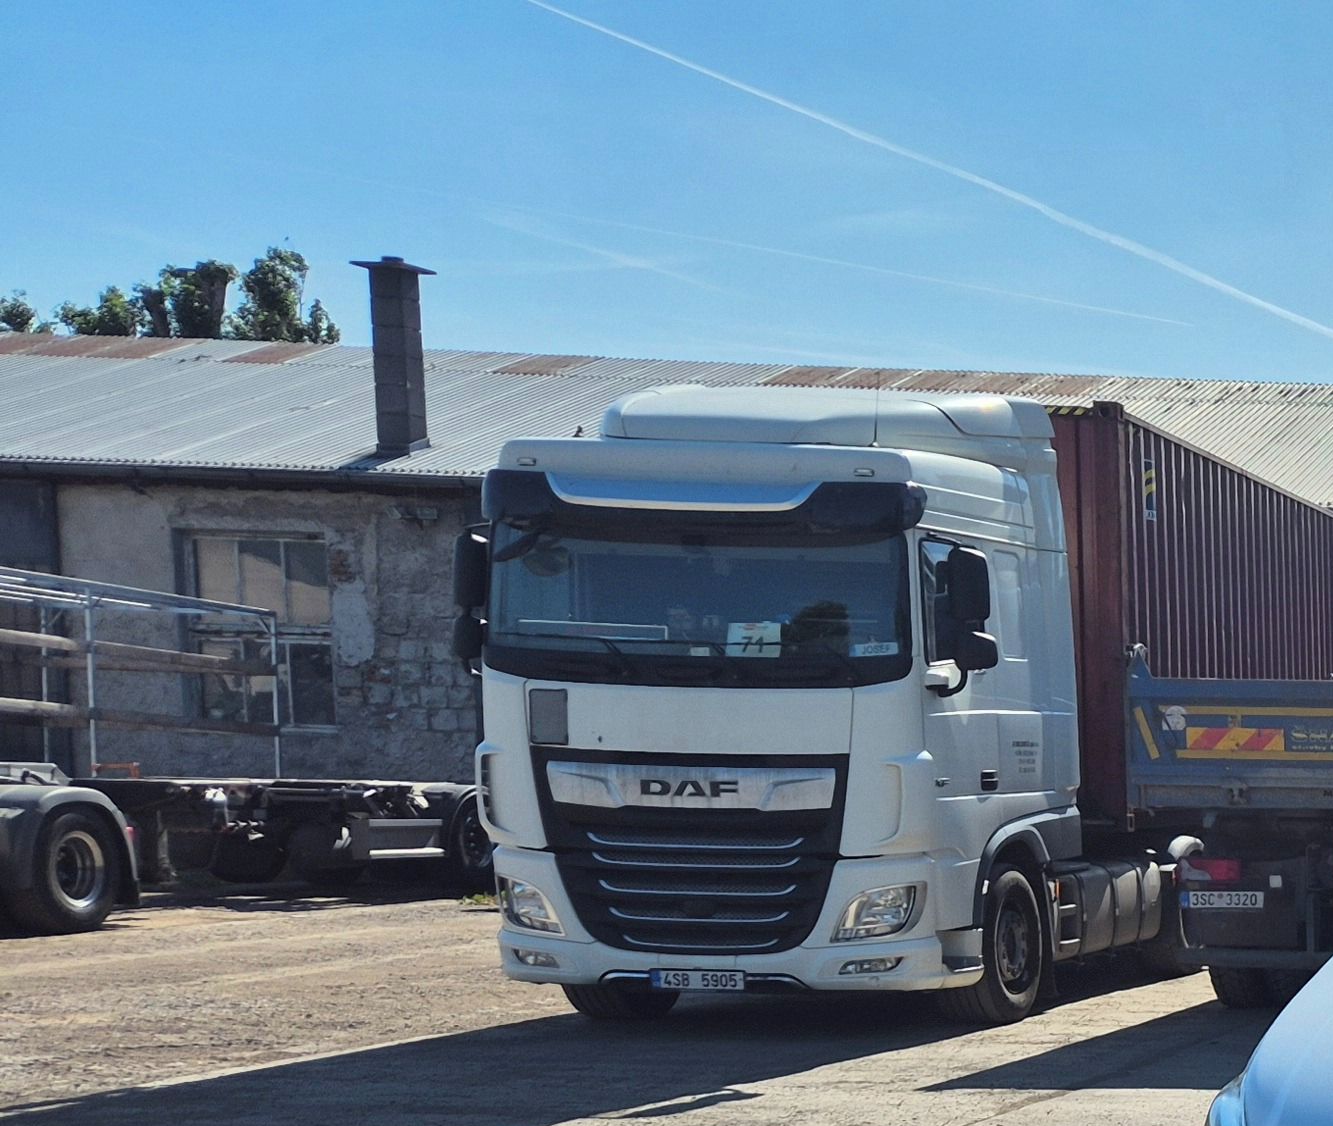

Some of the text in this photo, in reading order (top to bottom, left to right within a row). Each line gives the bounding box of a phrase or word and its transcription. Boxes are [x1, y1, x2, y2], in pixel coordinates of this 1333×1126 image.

[640, 779, 739, 798] DAF
[1192, 893, 1216, 906] 3SC
[1225, 893, 1258, 906] 3320
[663, 972, 690, 987] 4SB
[701, 973, 738, 988] 5905
